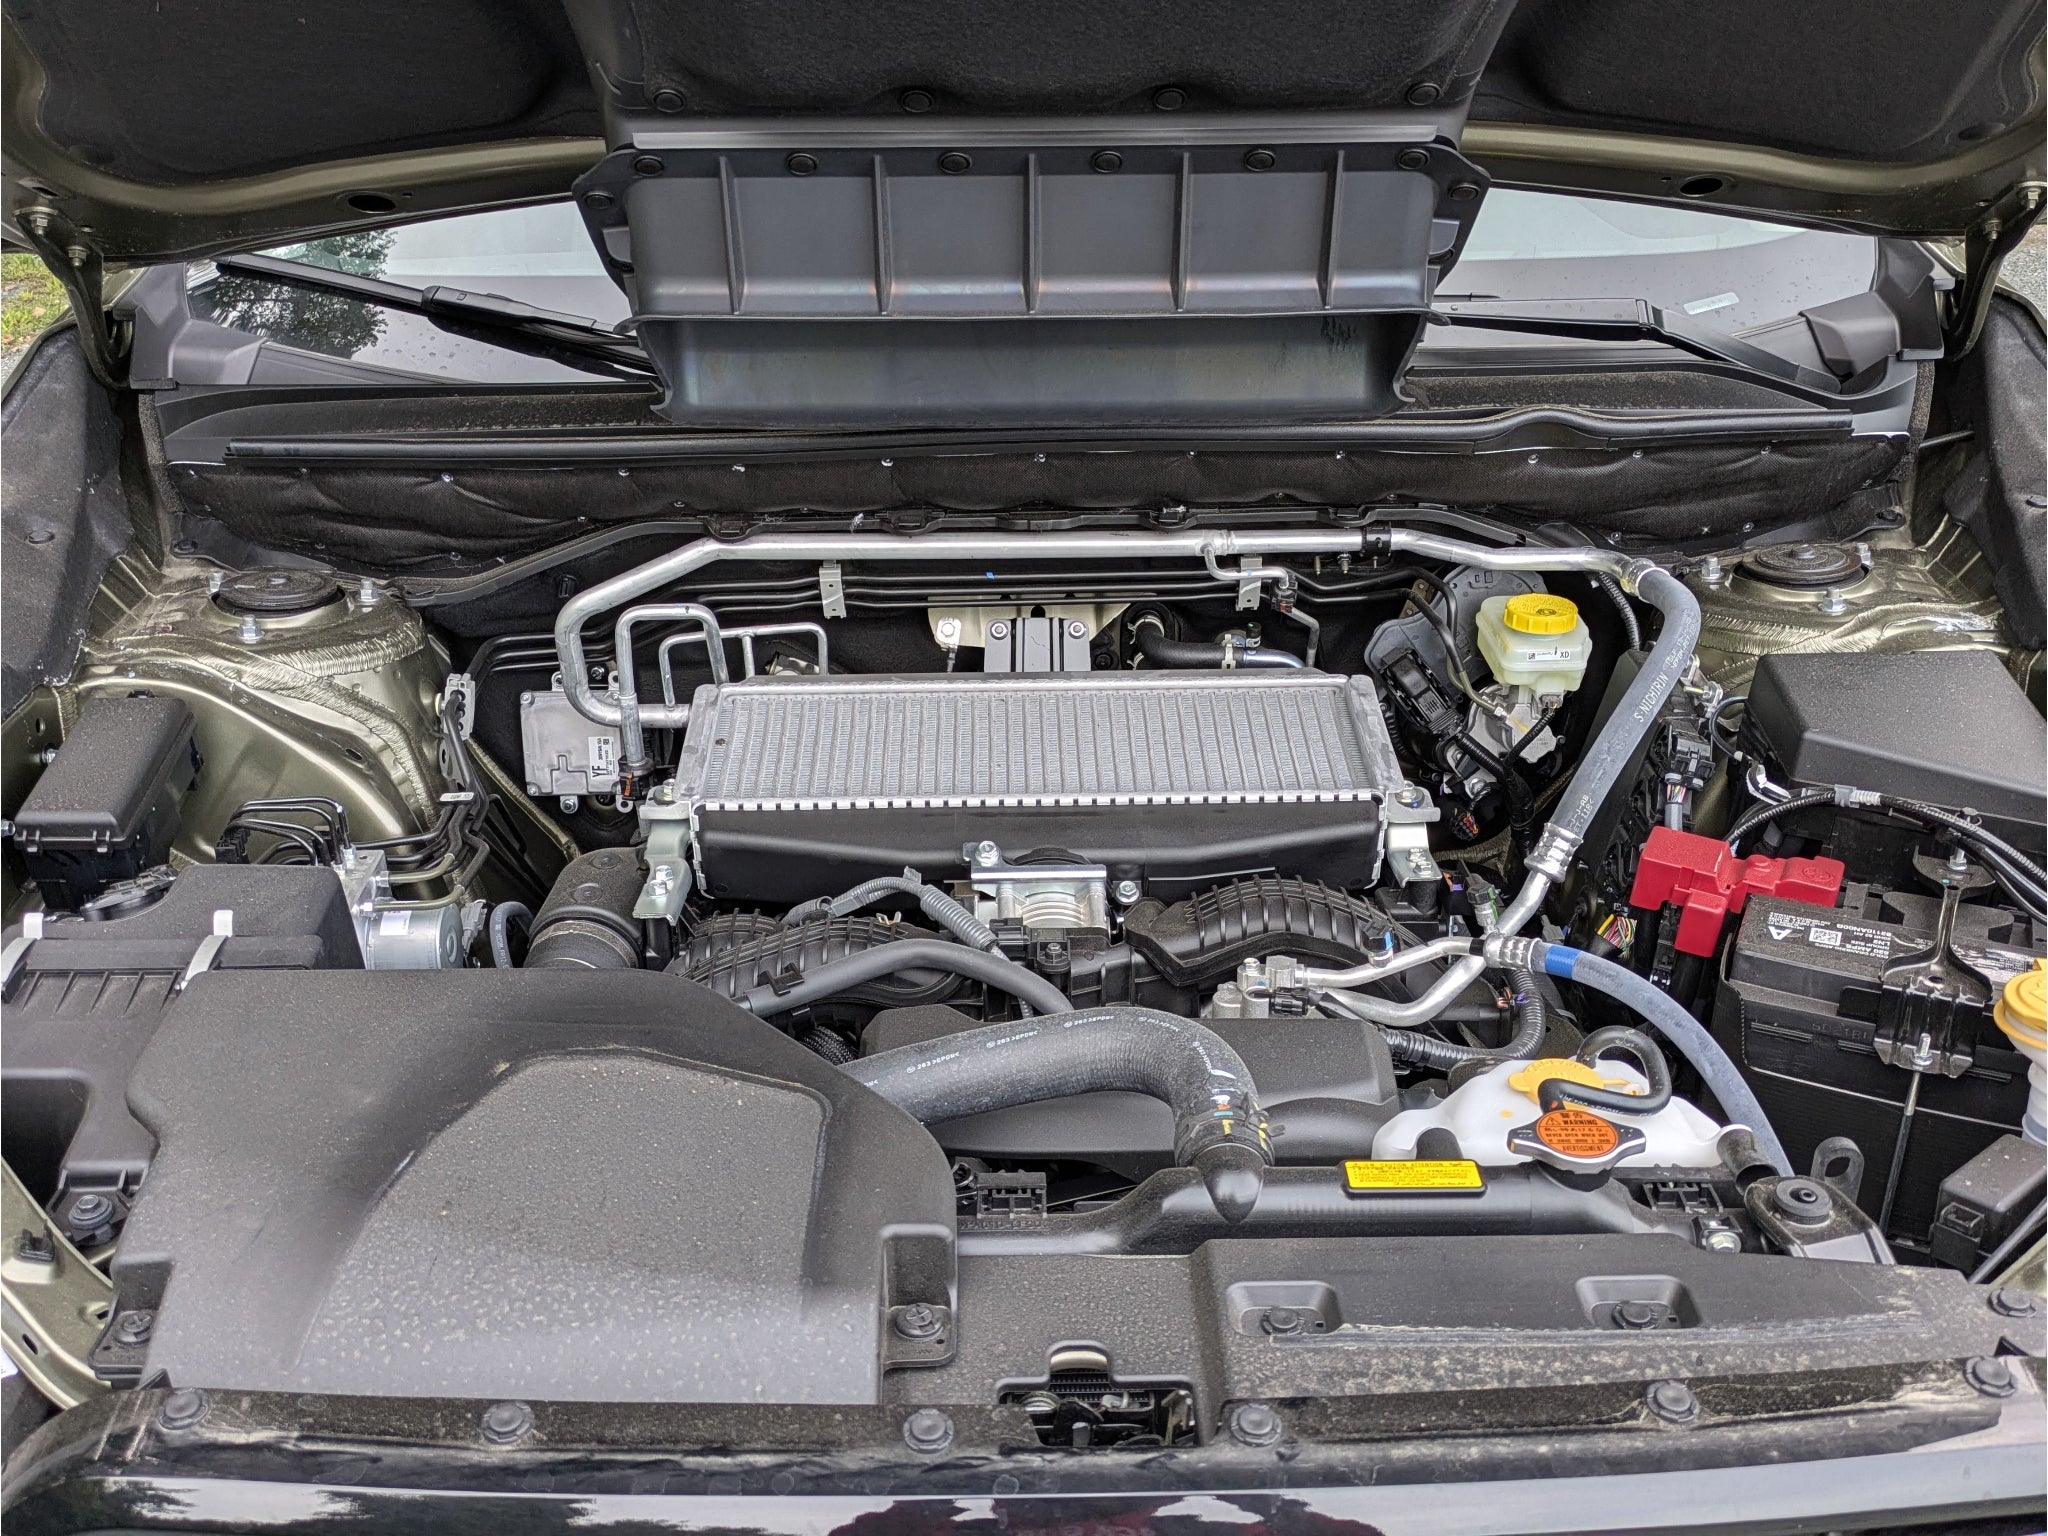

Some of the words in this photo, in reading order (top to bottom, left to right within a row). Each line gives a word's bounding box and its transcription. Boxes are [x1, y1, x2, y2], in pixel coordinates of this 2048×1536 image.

[1559, 651, 1569, 659] XD
[592, 766, 607, 778] YF
[1845, 943, 1872, 952] AMPS
